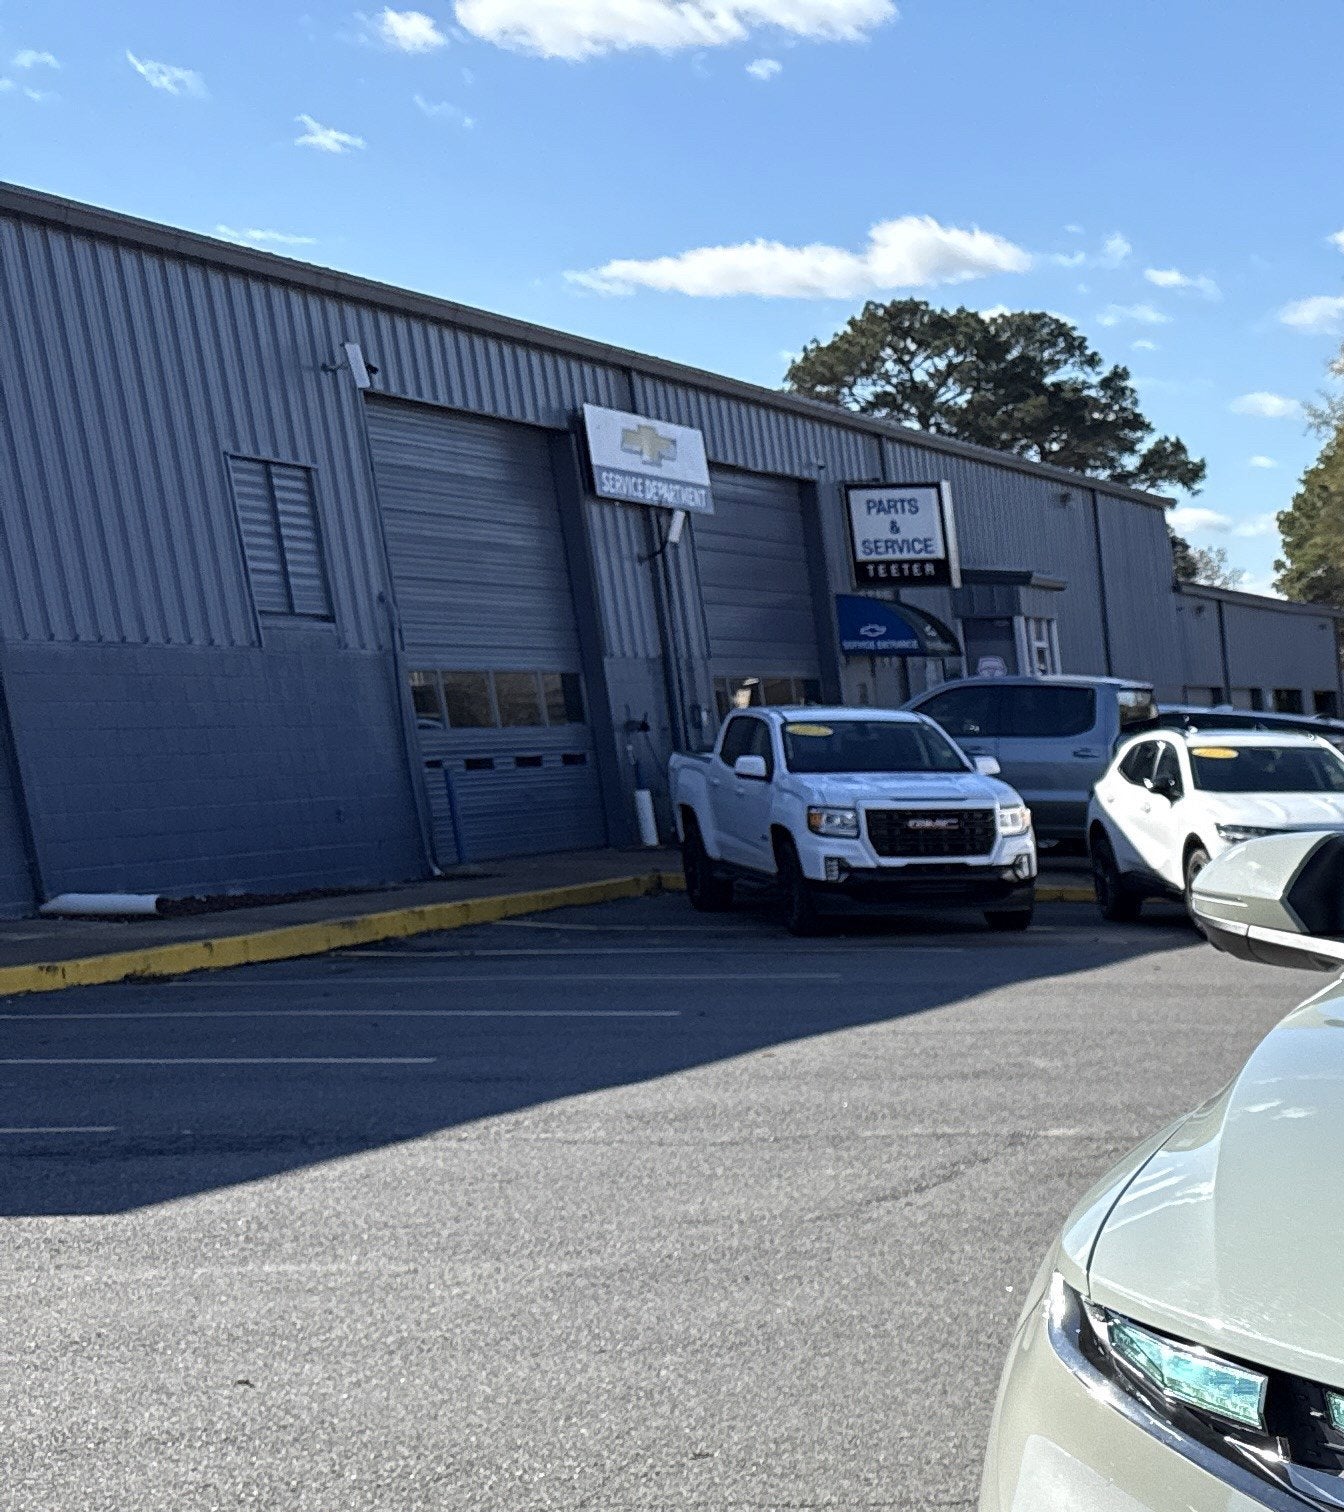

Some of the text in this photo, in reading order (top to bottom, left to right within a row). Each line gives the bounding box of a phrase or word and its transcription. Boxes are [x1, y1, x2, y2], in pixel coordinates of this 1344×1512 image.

[601, 471, 707, 508] SERVICE DEPARTMENT
[866, 498, 919, 515] PARTS
[889, 520, 900, 534] &
[861, 537, 936, 556] SERVICE
[867, 562, 935, 577] TEETER
[908, 818, 959, 830] GMC
